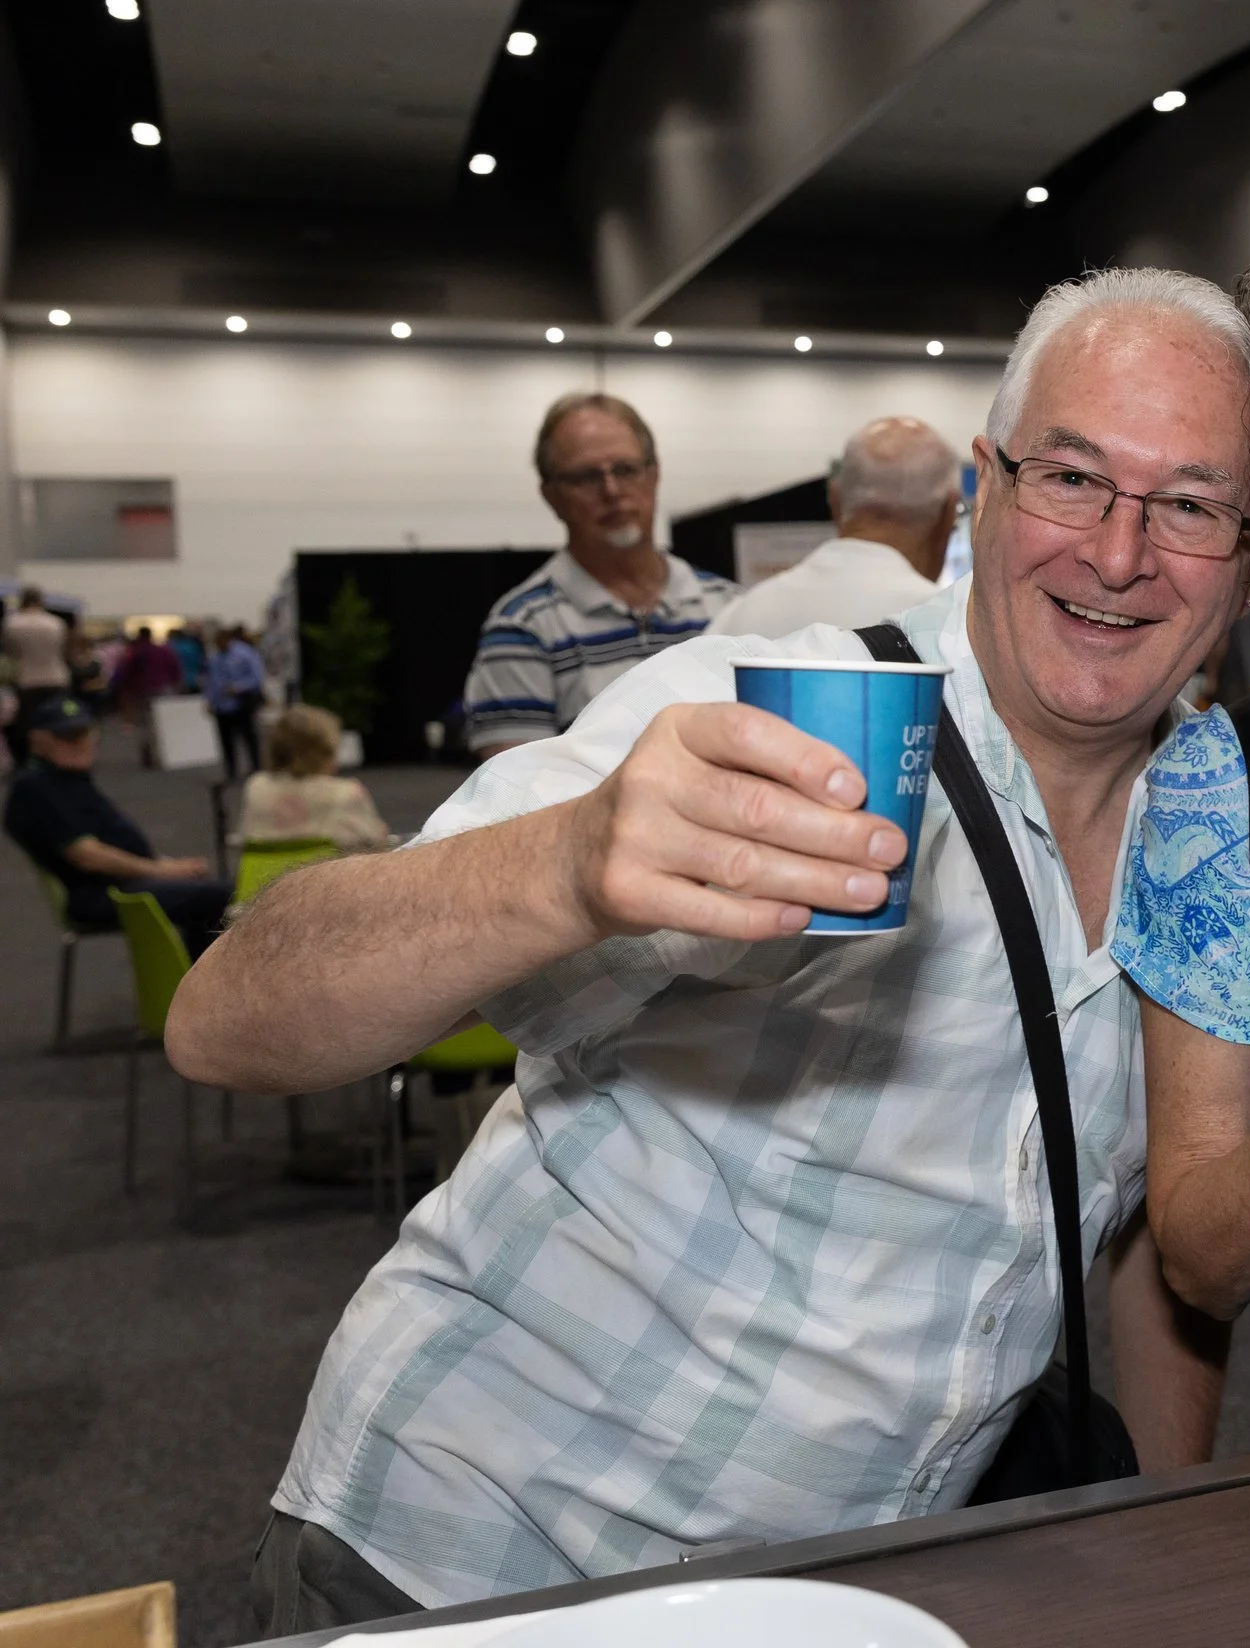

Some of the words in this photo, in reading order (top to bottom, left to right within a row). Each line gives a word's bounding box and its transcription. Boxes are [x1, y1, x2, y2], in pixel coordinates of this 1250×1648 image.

[902, 725, 926, 746] UP
[900, 749, 924, 771] OF
[897, 774, 915, 795] IN
